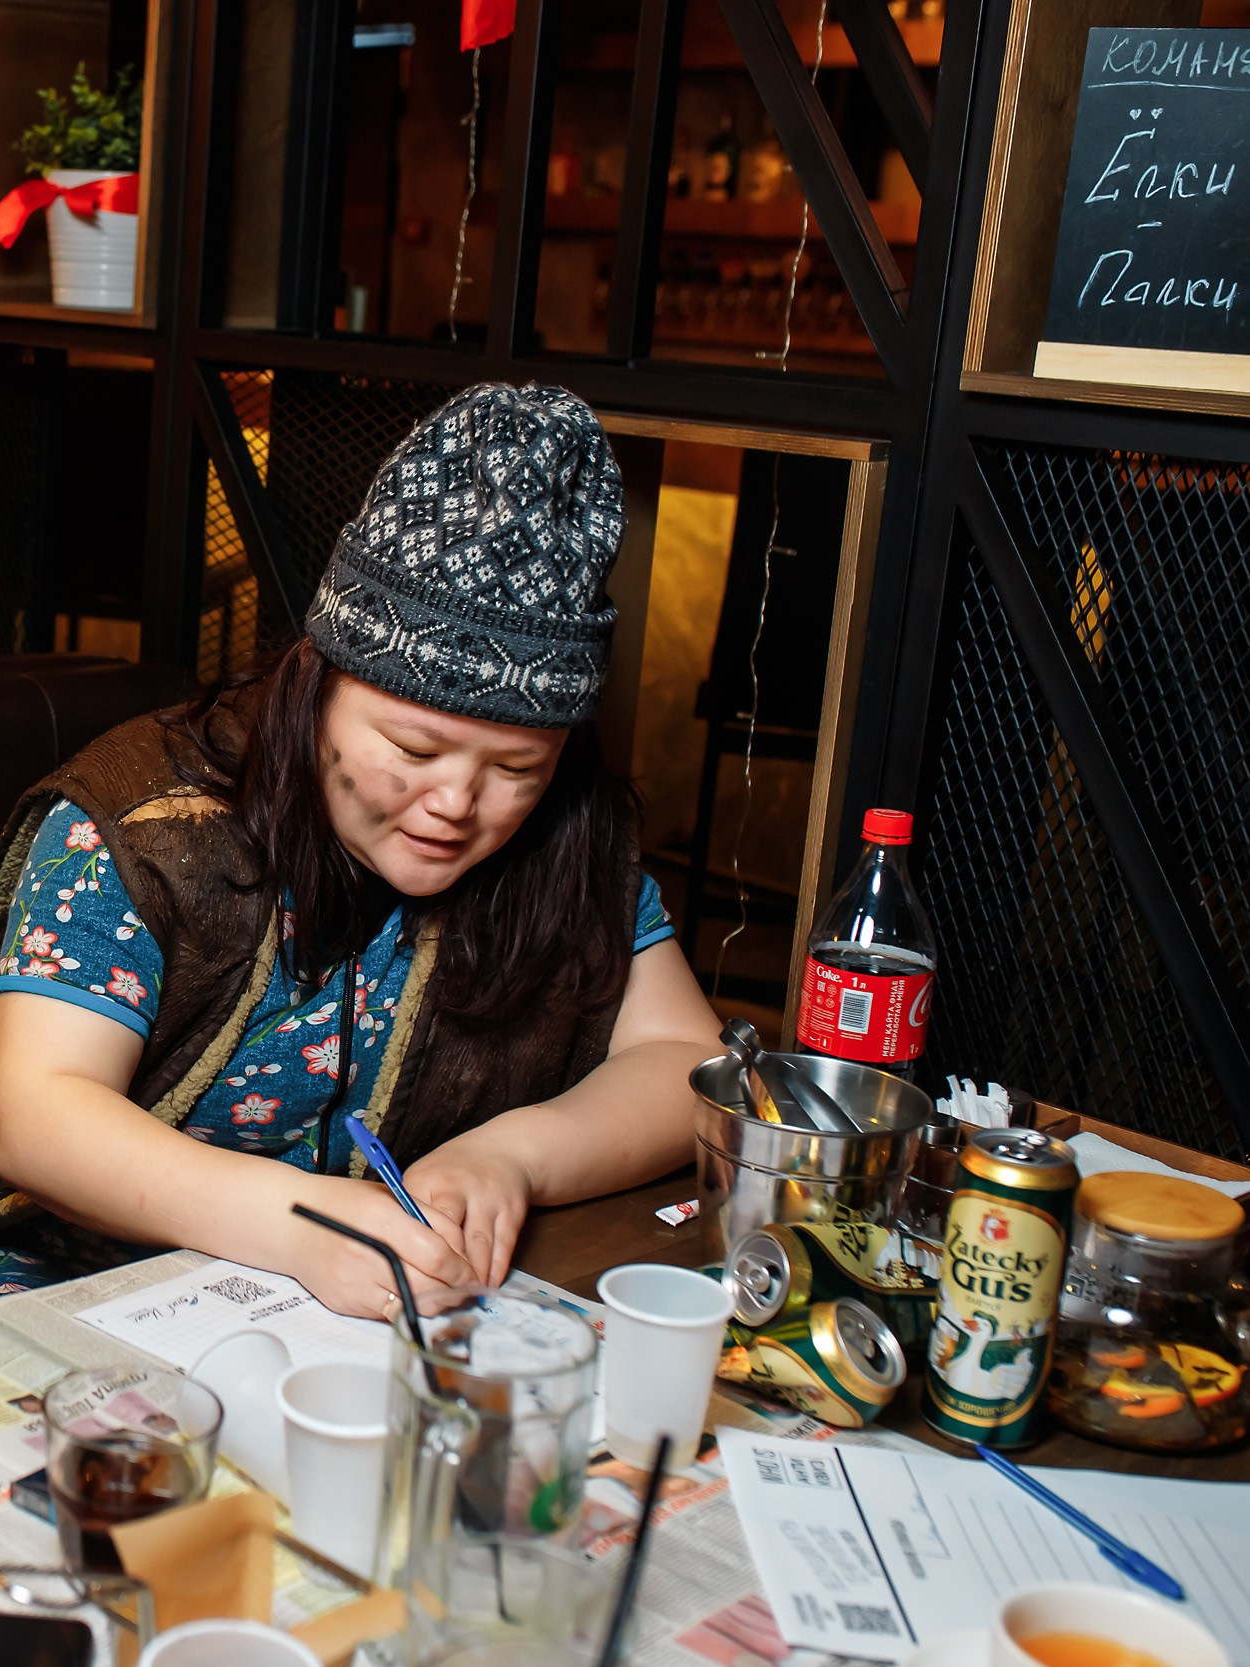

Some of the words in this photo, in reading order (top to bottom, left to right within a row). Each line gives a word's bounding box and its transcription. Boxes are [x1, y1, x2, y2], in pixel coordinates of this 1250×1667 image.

[1084, 107, 1236, 203] Ёлки
[1078, 249, 1238, 311] Палки
[952, 1258, 1034, 1303] Gus
